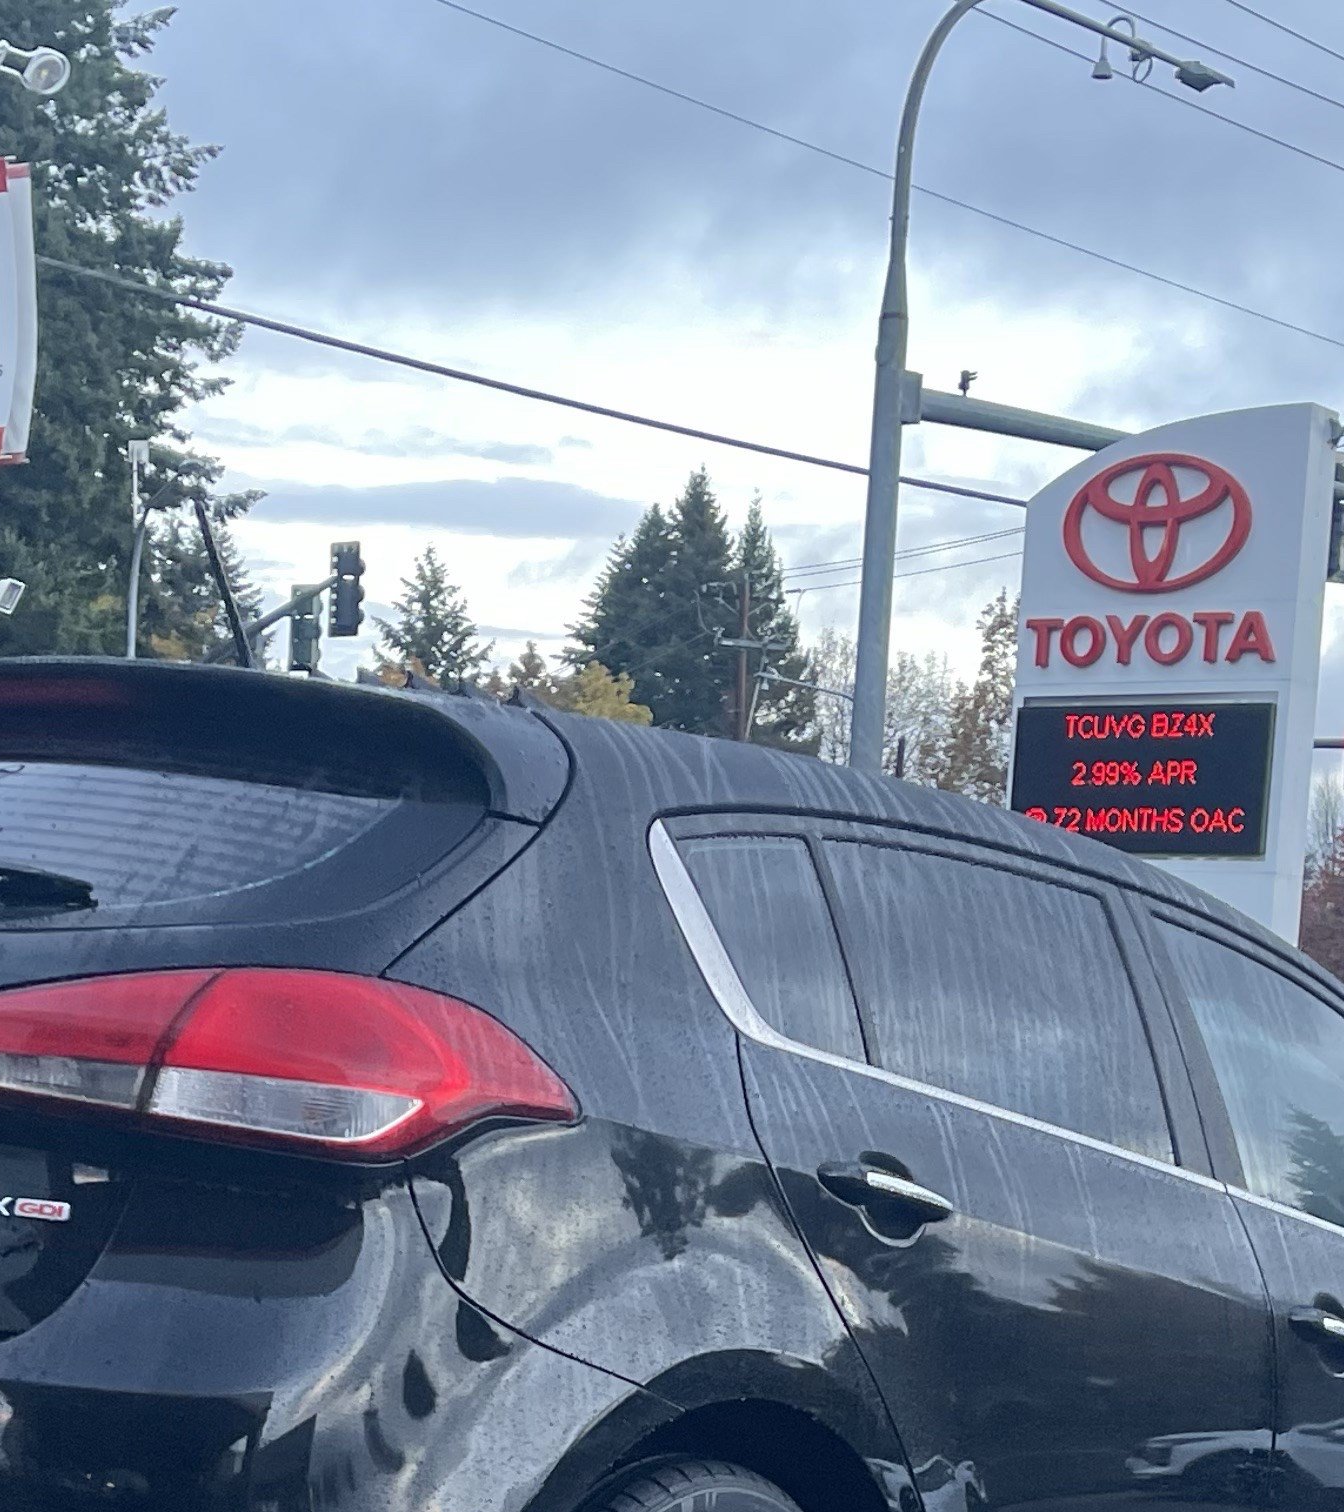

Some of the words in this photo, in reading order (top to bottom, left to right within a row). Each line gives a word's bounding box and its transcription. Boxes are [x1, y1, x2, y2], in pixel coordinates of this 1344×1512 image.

[1026, 611, 1276, 669] TOYOTA
[1151, 712, 1216, 738] BZ4X
[1071, 761, 1142, 786] 2.99%
[1147, 760, 1198, 785] APR
[1053, 807, 1081, 832] 72
[1085, 807, 1184, 833] MONTHS
[1190, 807, 1246, 833] OAC
[19, 1202, 65, 1218] GDI
